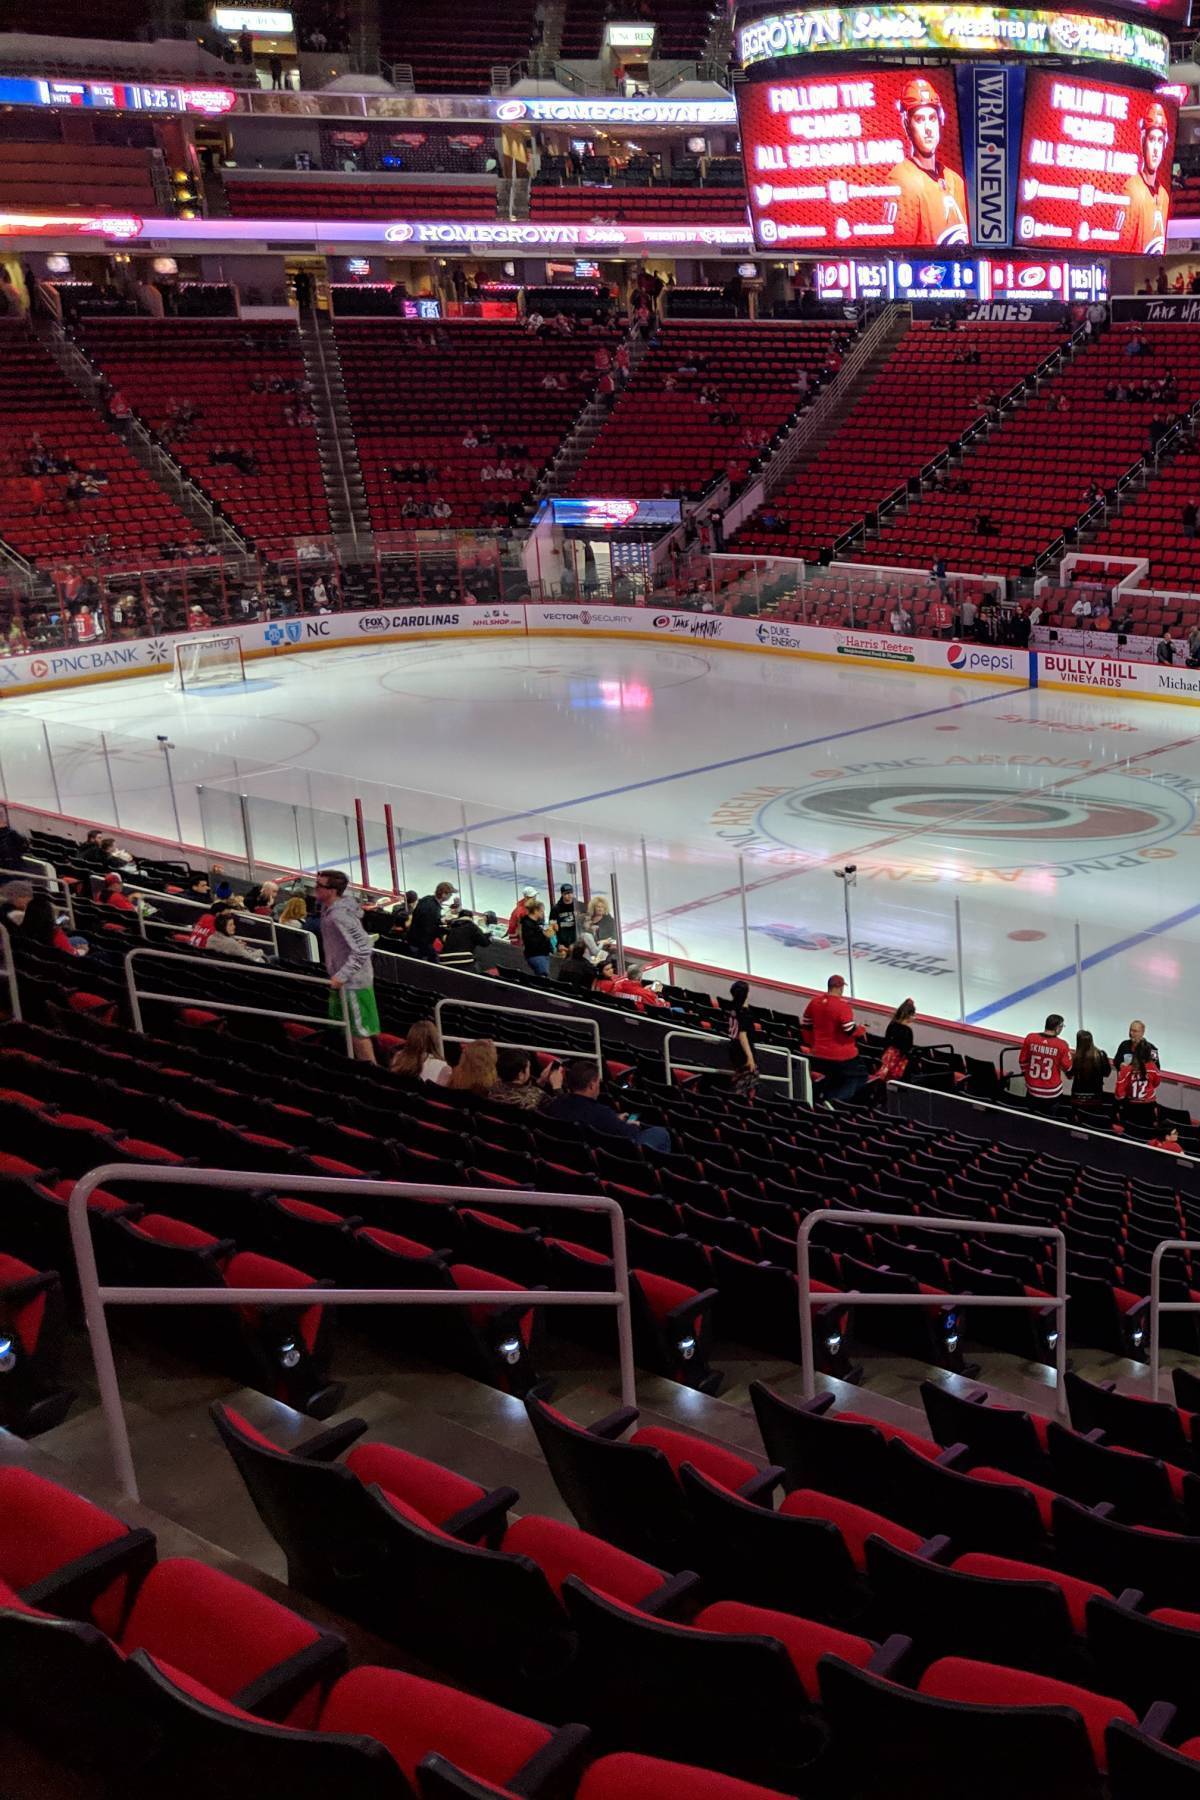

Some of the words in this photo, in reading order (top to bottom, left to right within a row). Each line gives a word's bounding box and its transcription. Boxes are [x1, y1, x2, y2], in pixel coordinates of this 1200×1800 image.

[1028, 21, 1047, 40] BY
[839, 82, 876, 108] THE
[977, 72, 1005, 150] WRAL
[756, 145, 787, 169] ALL
[788, 142, 856, 168] SEASON
[857, 139, 905, 165] LONG
[1030, 139, 1055, 165] ALL
[980, 152, 1003, 240] NEWS
[418, 224, 579, 242] HOMEGROWN
[898, 263, 913, 287] 0
[1049, 265, 1062, 289] 0
[967, 304, 1033, 321] CANES
[1146, 300, 1177, 320] TAKE
[365, 617, 384, 627] FOX
[393, 614, 460, 628] CAROLINAS
[543, 612, 579, 621] VECTOR
[591, 613, 633, 623] SECURITY
[671, 614, 690, 628] TAKE
[306, 621, 331, 637] NC
[770, 625, 791, 637] DUKE
[771, 636, 801, 649] ENERGY
[846, 635, 879, 650] Harris
[880, 640, 914, 654] Teeter
[52, 655, 90, 674] PNC
[91, 647, 140, 667] BANK
[970, 650, 1014, 671] pepsi
[1044, 656, 1096, 675] BULLY
[1100, 662, 1138, 680] HILL
[1060, 672, 1122, 688] VINEYARDS
[843, 757, 929, 773] PNC
[944, 754, 1093, 769] ARENA
[1039, 855, 1151, 879] PNC
[851, 941, 914, 958] CLICK
[915, 955, 948, 964] IT
[868, 954, 956, 977] TICKET
[1029, 1043, 1059, 1057] SKINNER
[1029, 1055, 1054, 1080] 53
[1131, 1079, 1148, 1098] 12
